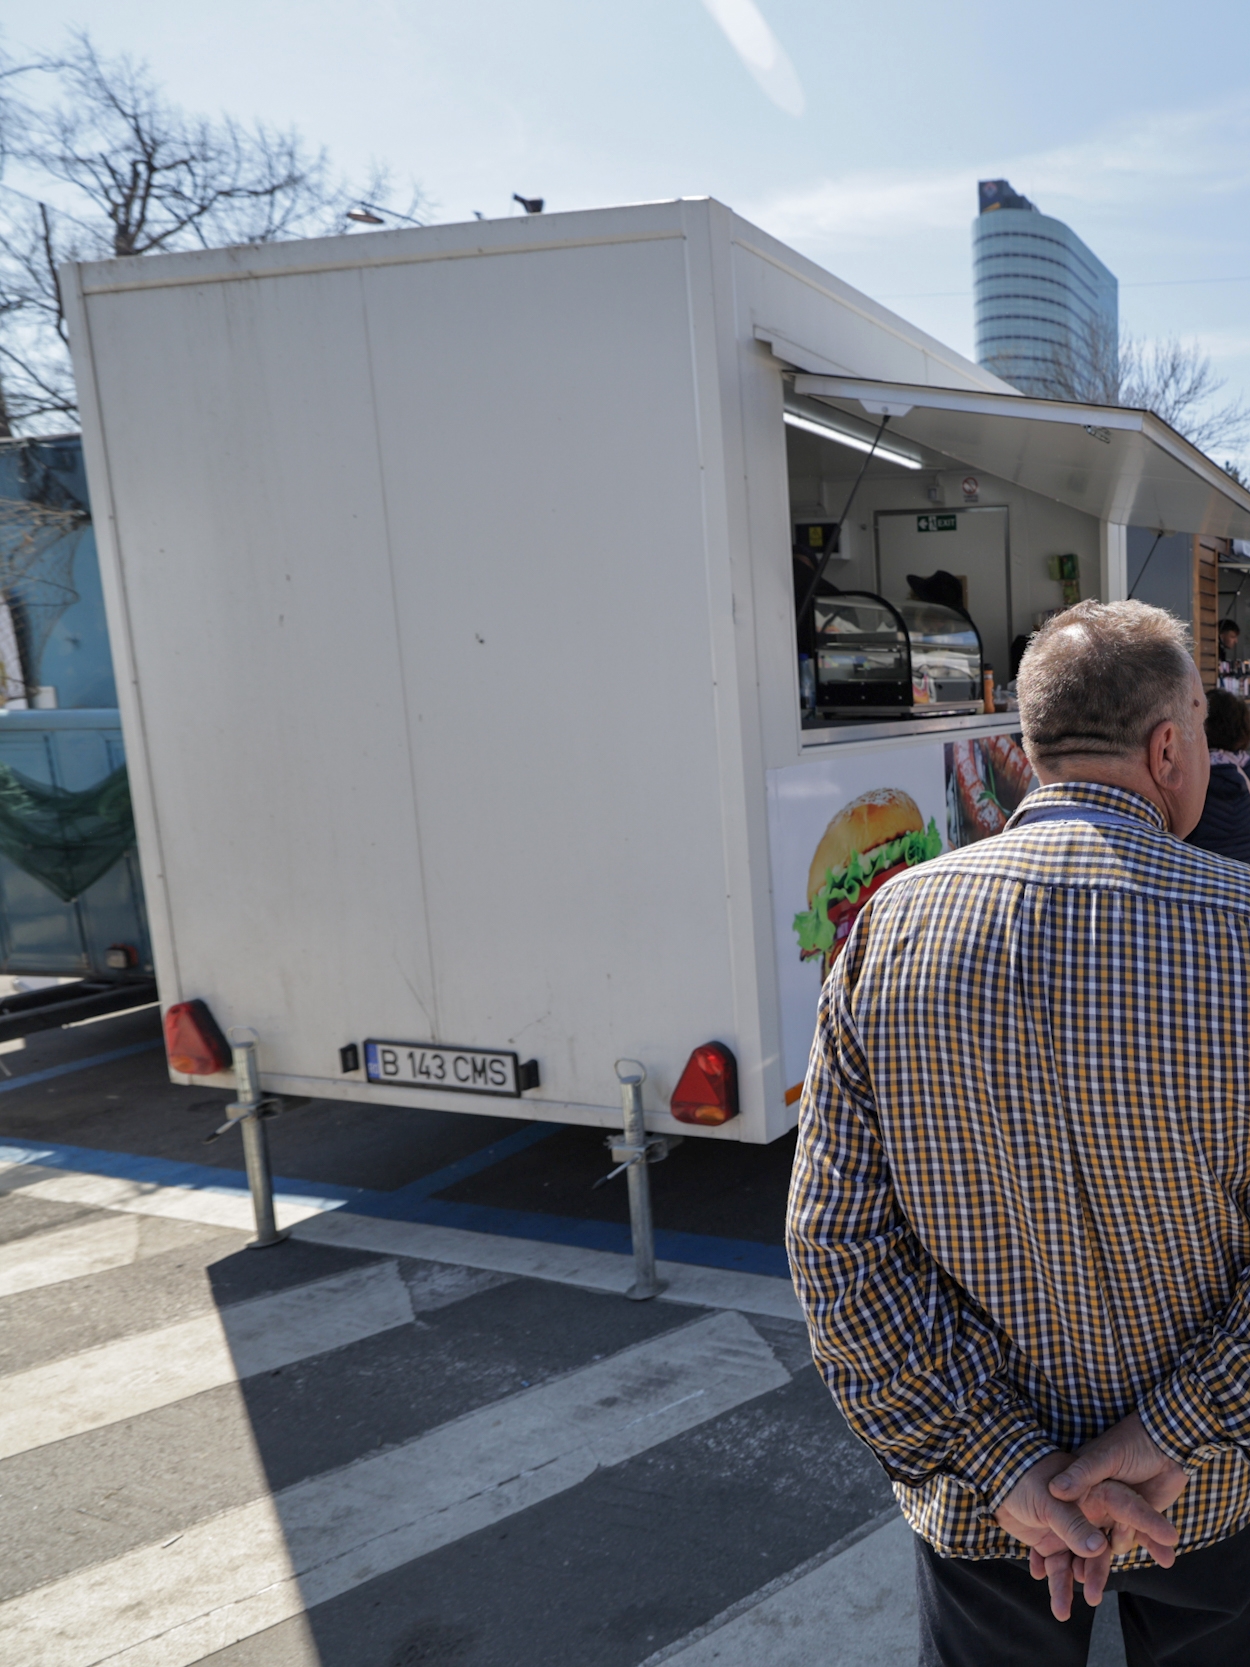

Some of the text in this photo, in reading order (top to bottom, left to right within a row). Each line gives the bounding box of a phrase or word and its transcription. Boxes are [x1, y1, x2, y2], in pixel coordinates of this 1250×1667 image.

[937, 518, 955, 528] EXIT
[367, 1063, 379, 1075] RO
[381, 1049, 507, 1086] B 143 CMS
